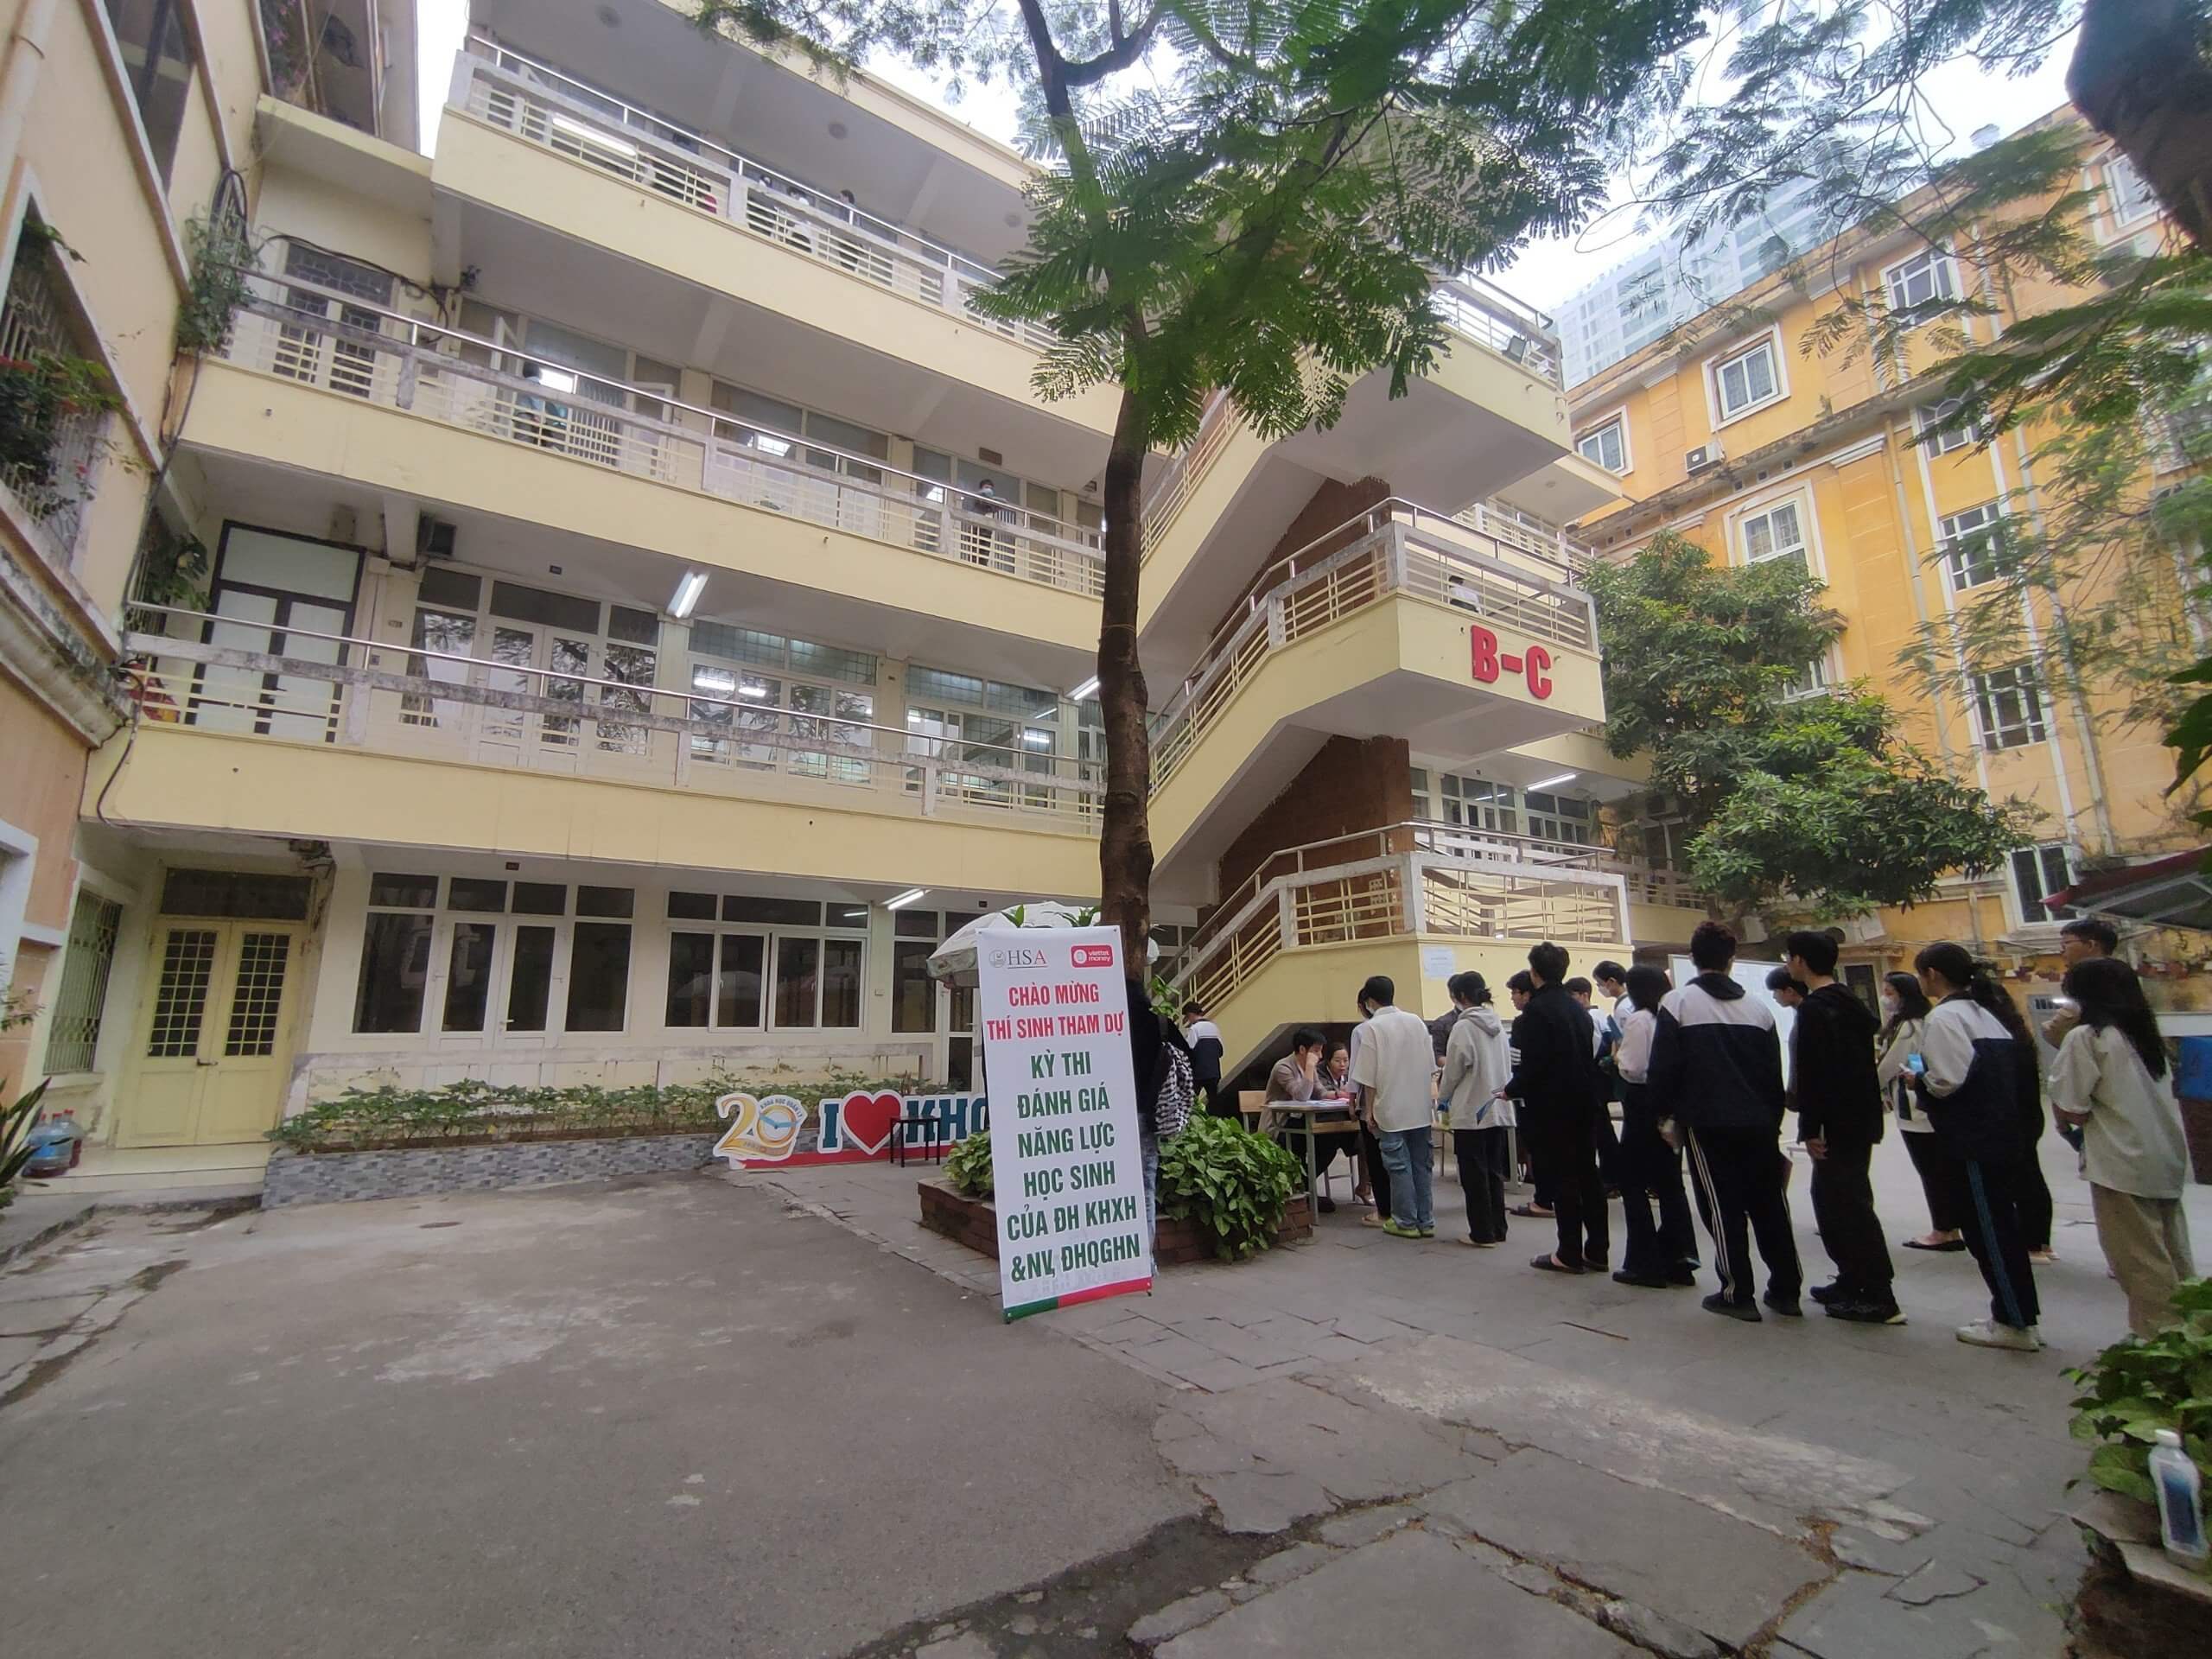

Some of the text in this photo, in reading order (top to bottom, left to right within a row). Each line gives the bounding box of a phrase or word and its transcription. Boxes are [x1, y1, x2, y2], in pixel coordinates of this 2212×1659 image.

[1471, 625, 1553, 700] B-C
[1008, 950, 1046, 965] HSA
[1008, 980, 1100, 1007] CHÀO MỪNG
[987, 1010, 1123, 1039] THÍ SINH THAM DỰ
[1031, 1049, 1091, 1079] KỲ THI
[1017, 1082, 1109, 1119] ĐÁNH GIÁ
[822, 1103, 840, 1148] I
[1018, 1122, 1115, 1159] NĂNG LỰC
[1023, 1160, 1116, 1201] HỌC SINH
[1007, 1196, 1137, 1241] CỦA ĐH KHXH
[1061, 1234, 1141, 1272] ĐHQGHN
